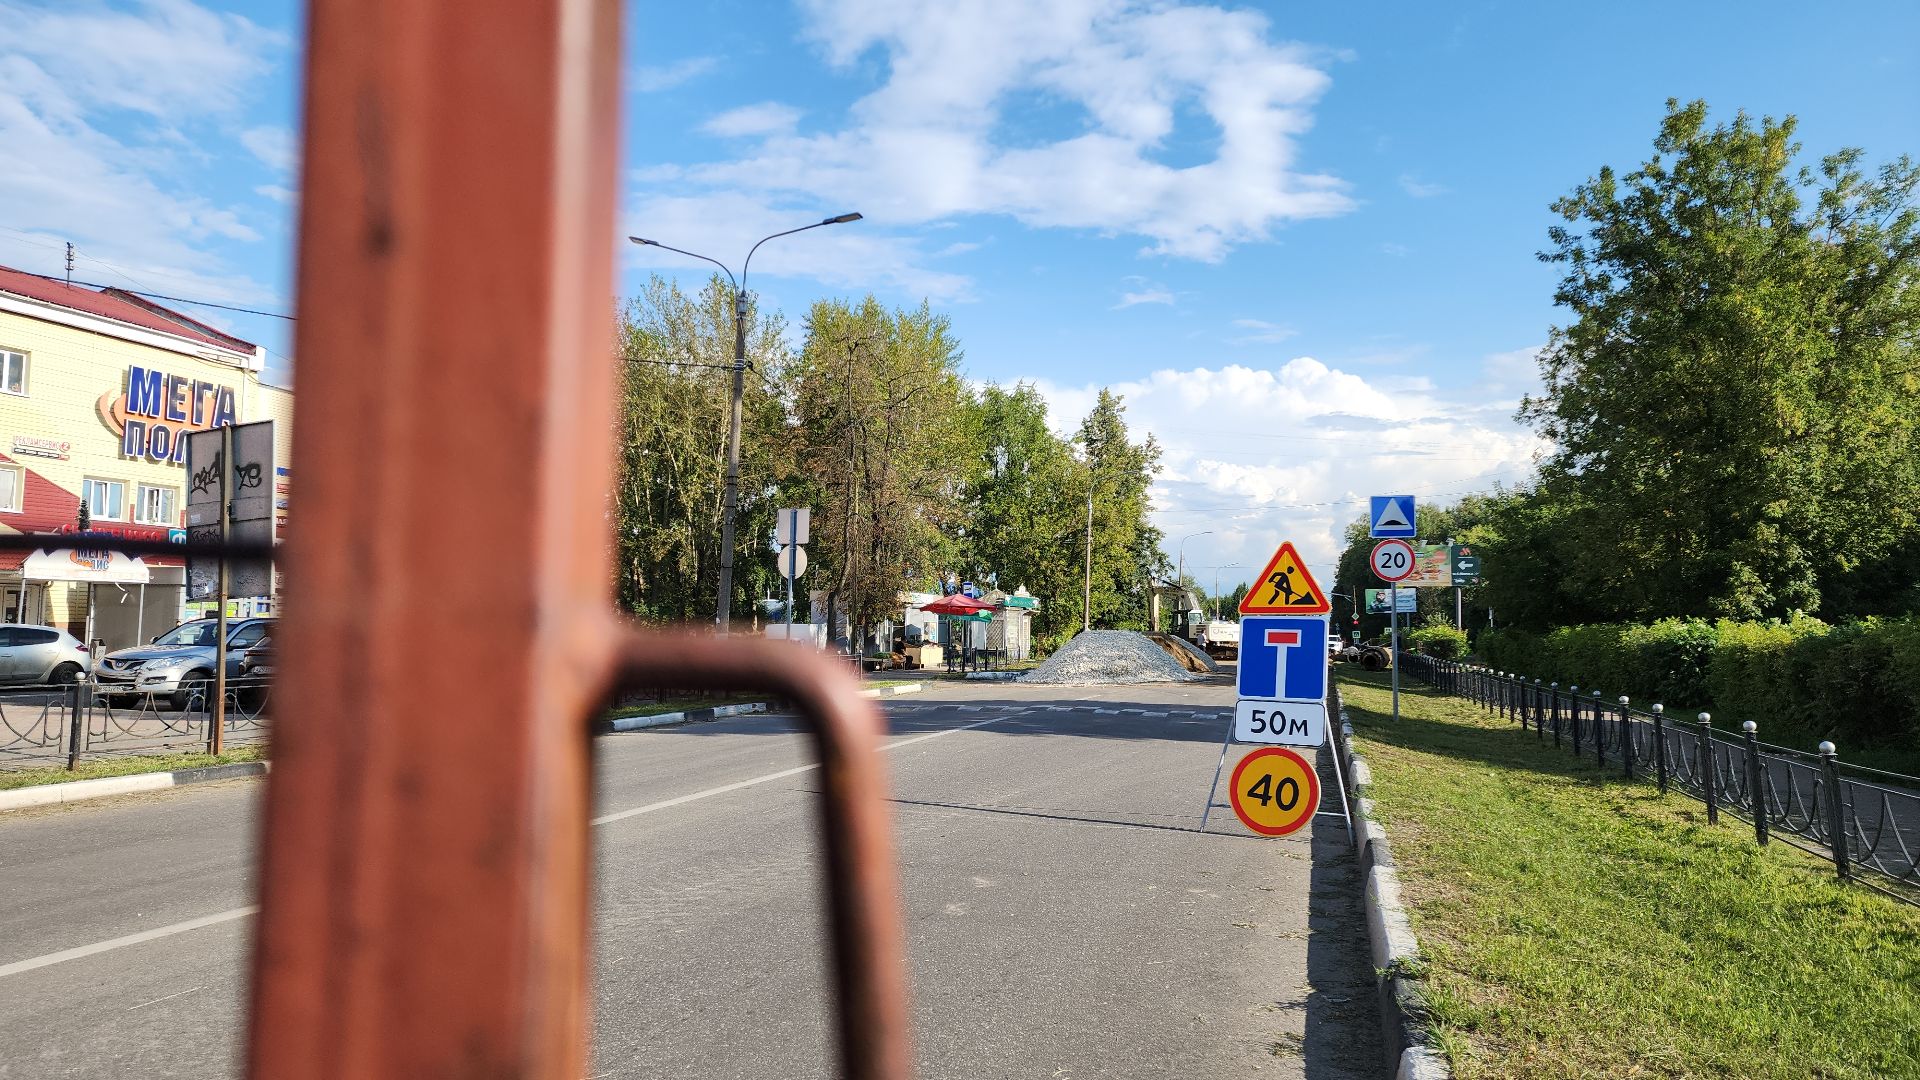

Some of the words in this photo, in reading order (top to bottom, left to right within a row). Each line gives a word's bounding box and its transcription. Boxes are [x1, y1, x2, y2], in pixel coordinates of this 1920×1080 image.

[126, 364, 237, 428] МЕГА
[1381, 552, 1406, 569] 20
[1246, 773, 1300, 812] 40
